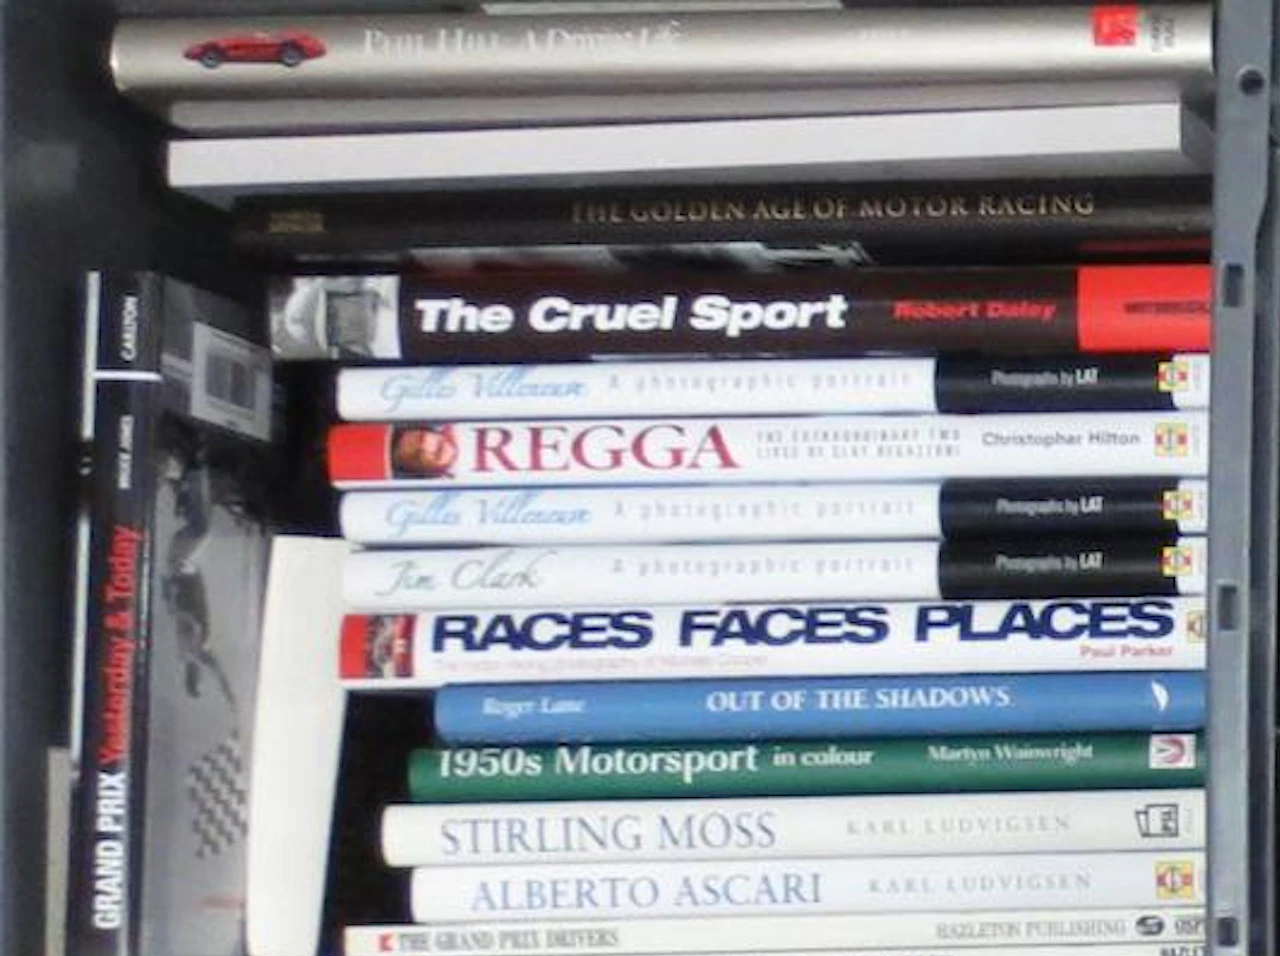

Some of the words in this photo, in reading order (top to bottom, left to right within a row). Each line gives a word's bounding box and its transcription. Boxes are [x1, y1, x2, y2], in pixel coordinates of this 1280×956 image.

[416, 299, 515, 332] The
[529, 296, 677, 332] Cruel
[690, 295, 848, 336] Sport
[472, 425, 742, 473] REGGA
[982, 432, 1082, 446] Christopher
[1089, 430, 1141, 445] Hilton
[432, 614, 653, 653] RACES
[680, 607, 889, 647] FACES
[914, 601, 1174, 642] PLACES
[706, 691, 763, 712] OUT
[771, 691, 806, 710] OF
[817, 689, 872, 709] THE
[877, 684, 1010, 708] SHADOWS
[439, 748, 541, 778] 1950s
[555, 746, 758, 783] Motorsport
[773, 747, 796, 767] in
[802, 746, 874, 767] colour
[440, 818, 641, 855] STIRLING
[659, 812, 777, 849] MOSS
[470, 883, 658, 911] ALBERTO
[675, 872, 822, 905] ASCARI
